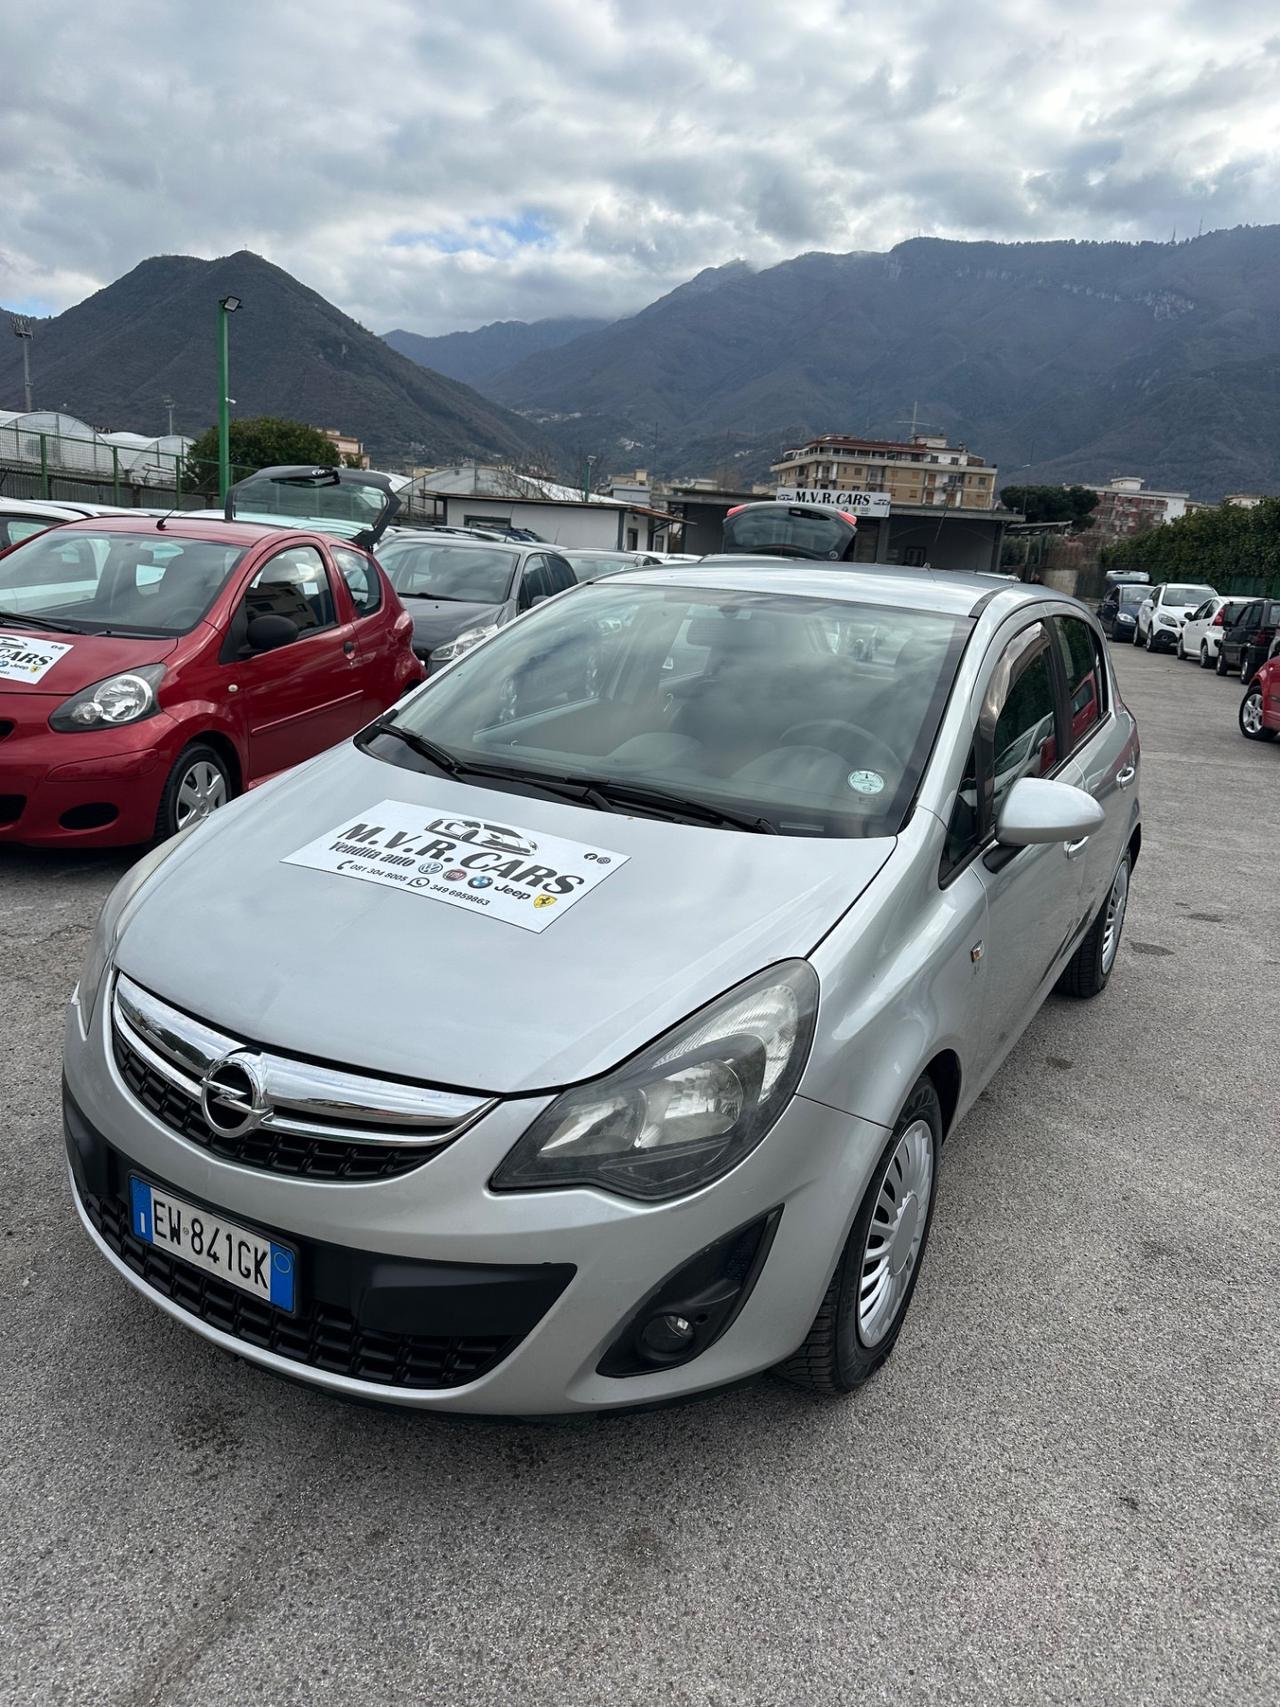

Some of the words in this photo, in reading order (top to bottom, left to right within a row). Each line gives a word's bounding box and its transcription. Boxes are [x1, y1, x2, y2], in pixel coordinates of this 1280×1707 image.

[329, 842, 382, 859] Vendita
[379, 854, 415, 866] auto
[430, 884, 448, 893] 349
[449, 888, 491, 906] 6959863
[494, 885, 531, 900] Jeep
